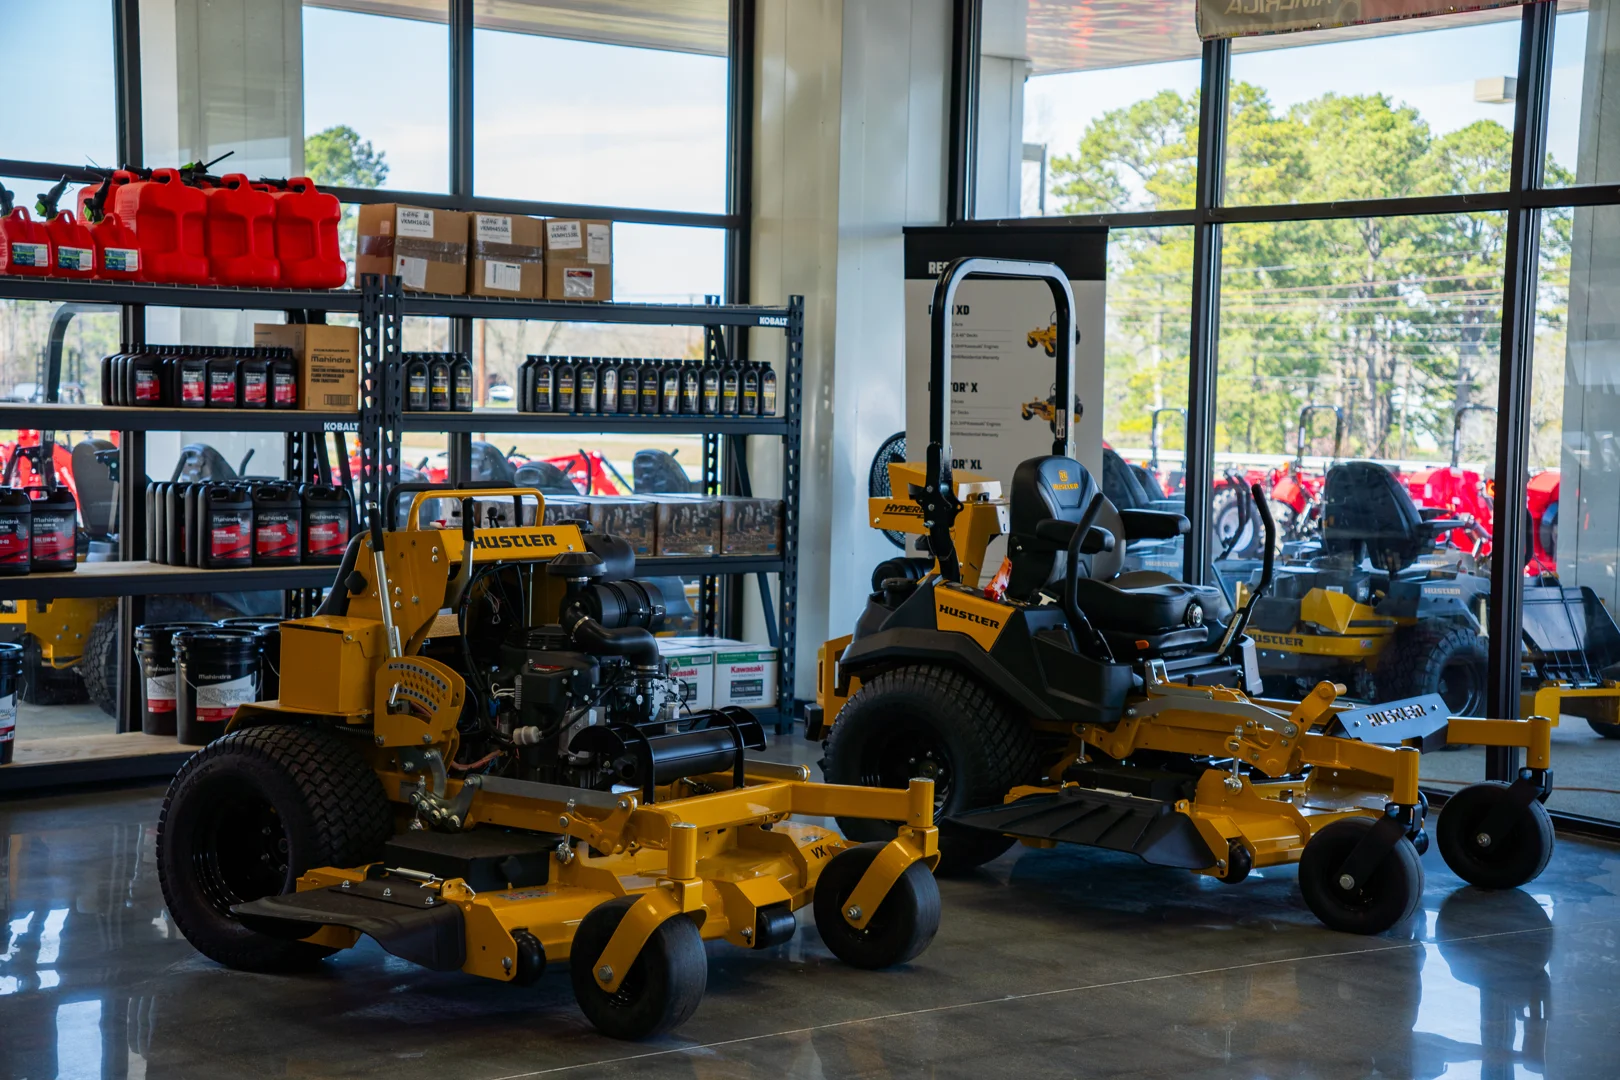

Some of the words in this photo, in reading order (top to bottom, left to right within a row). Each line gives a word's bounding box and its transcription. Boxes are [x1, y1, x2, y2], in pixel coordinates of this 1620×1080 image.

[956, 305, 970, 315] XD
[759, 316, 788, 326] KOBALT
[311, 355, 351, 364] Mahindra
[971, 381, 978, 393] X
[324, 422, 359, 431] KOBALT
[970, 459, 982, 470] XL
[473, 533, 557, 550] HUSTLER
[1424, 587, 1461, 595] HUSTLER
[939, 604, 1000, 630] HUSTLER
[730, 665, 764, 674] Kawasaki
[1366, 703, 1427, 728] HUSTLER
[811, 845, 827, 859] VX
